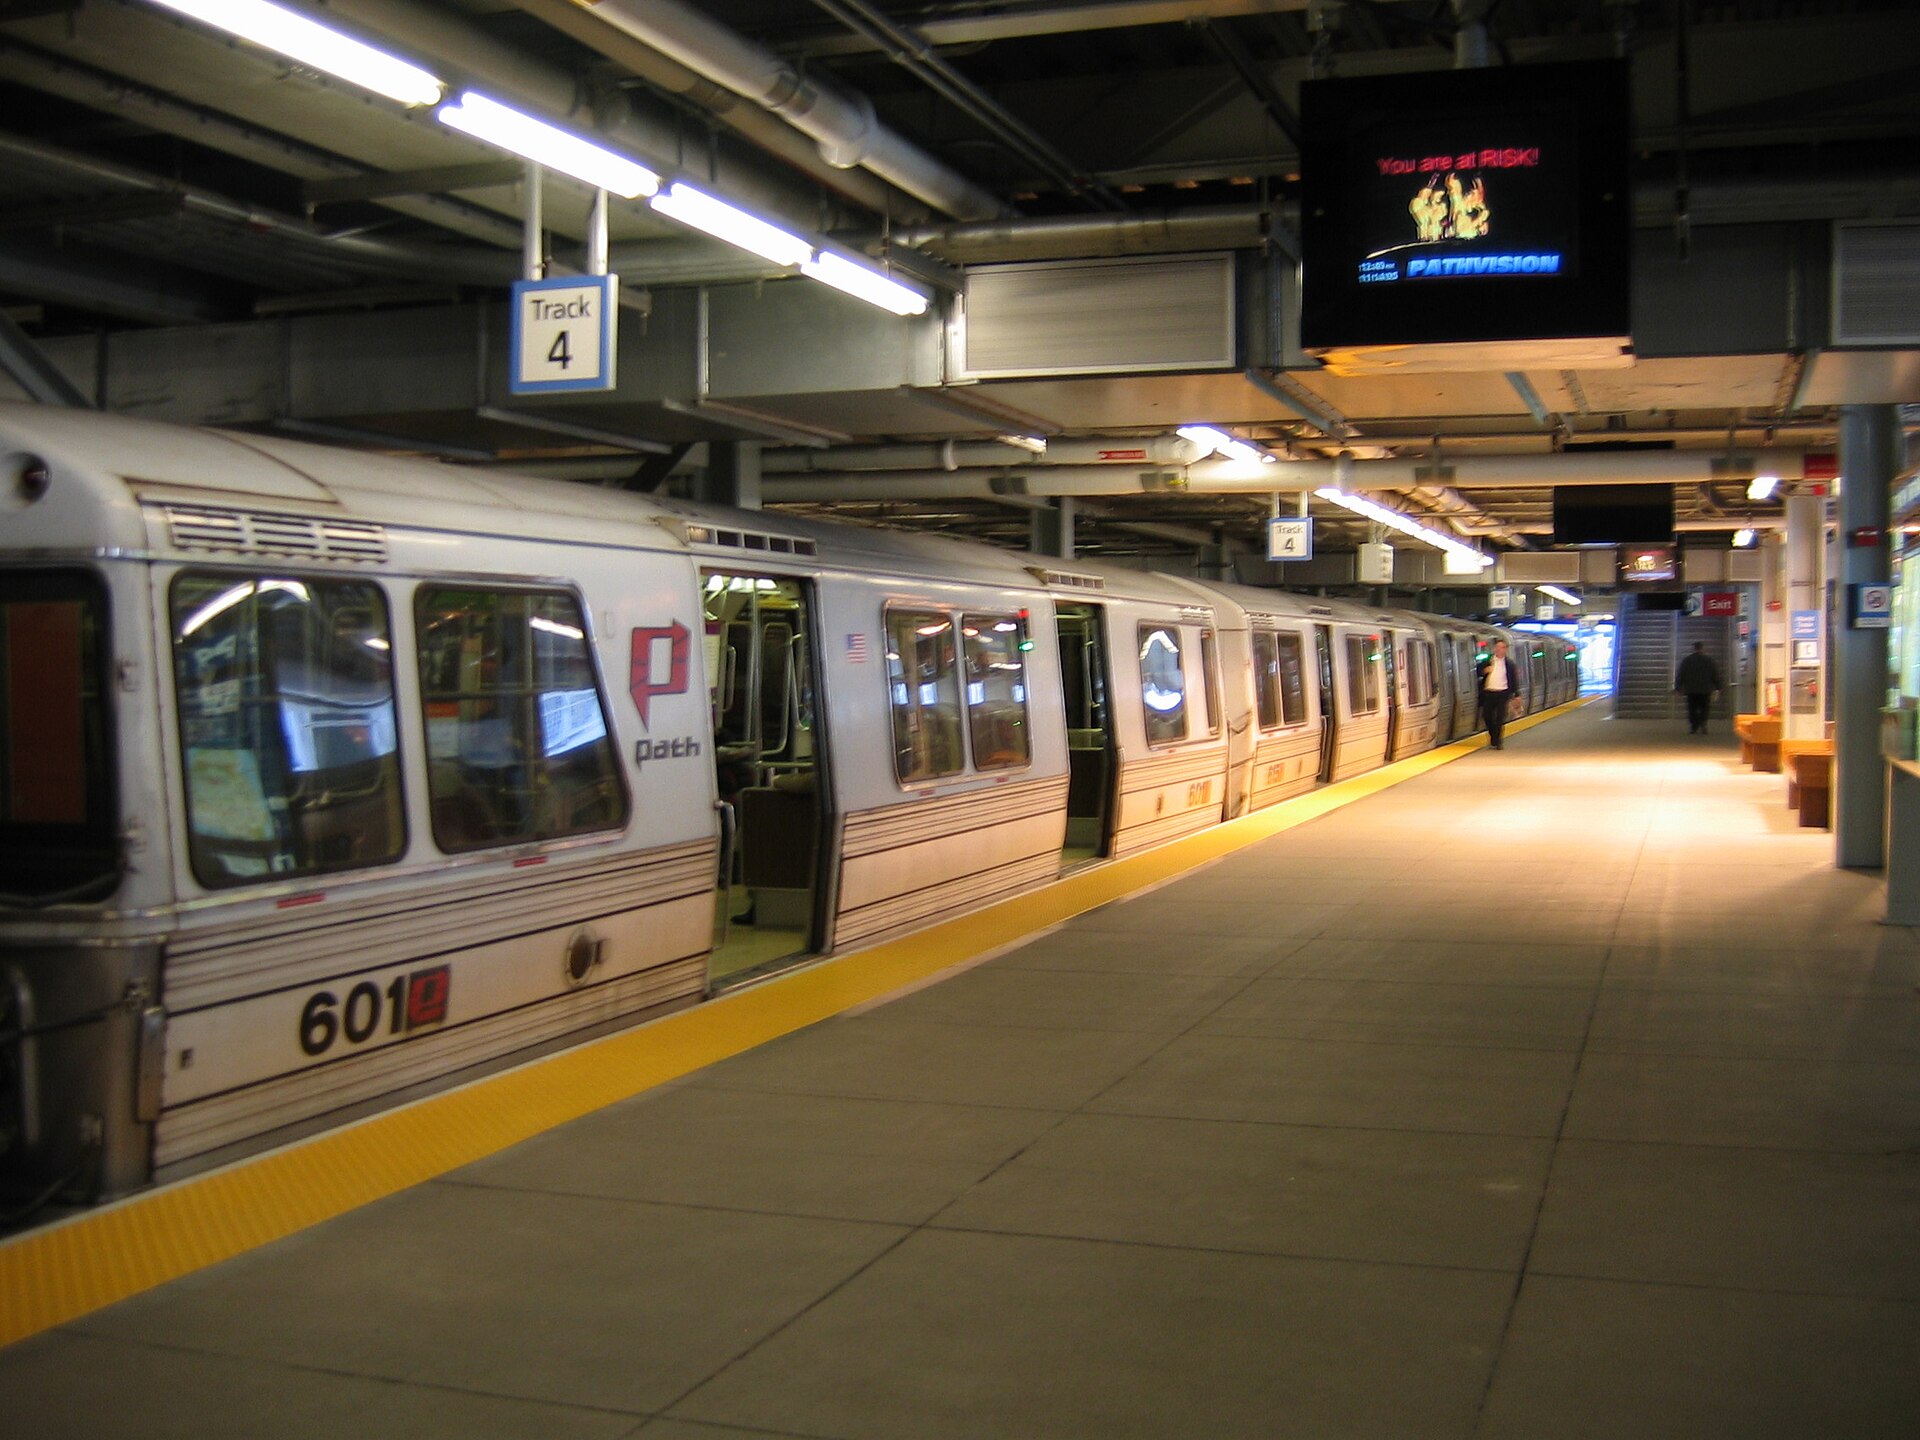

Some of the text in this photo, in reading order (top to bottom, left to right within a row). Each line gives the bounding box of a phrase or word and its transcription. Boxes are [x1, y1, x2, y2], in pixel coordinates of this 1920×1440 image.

[1377, 147, 1539, 175] You are at RISK!
[1406, 254, 1560, 278] PATHVISION
[530, 294, 591, 320] Track
[547, 330, 573, 370] 4
[1275, 524, 1304, 534] Track
[1284, 537, 1296, 552] 4
[1708, 599, 1732, 610] Exit
[636, 735, 700, 772] path
[300, 975, 405, 1056] 601
